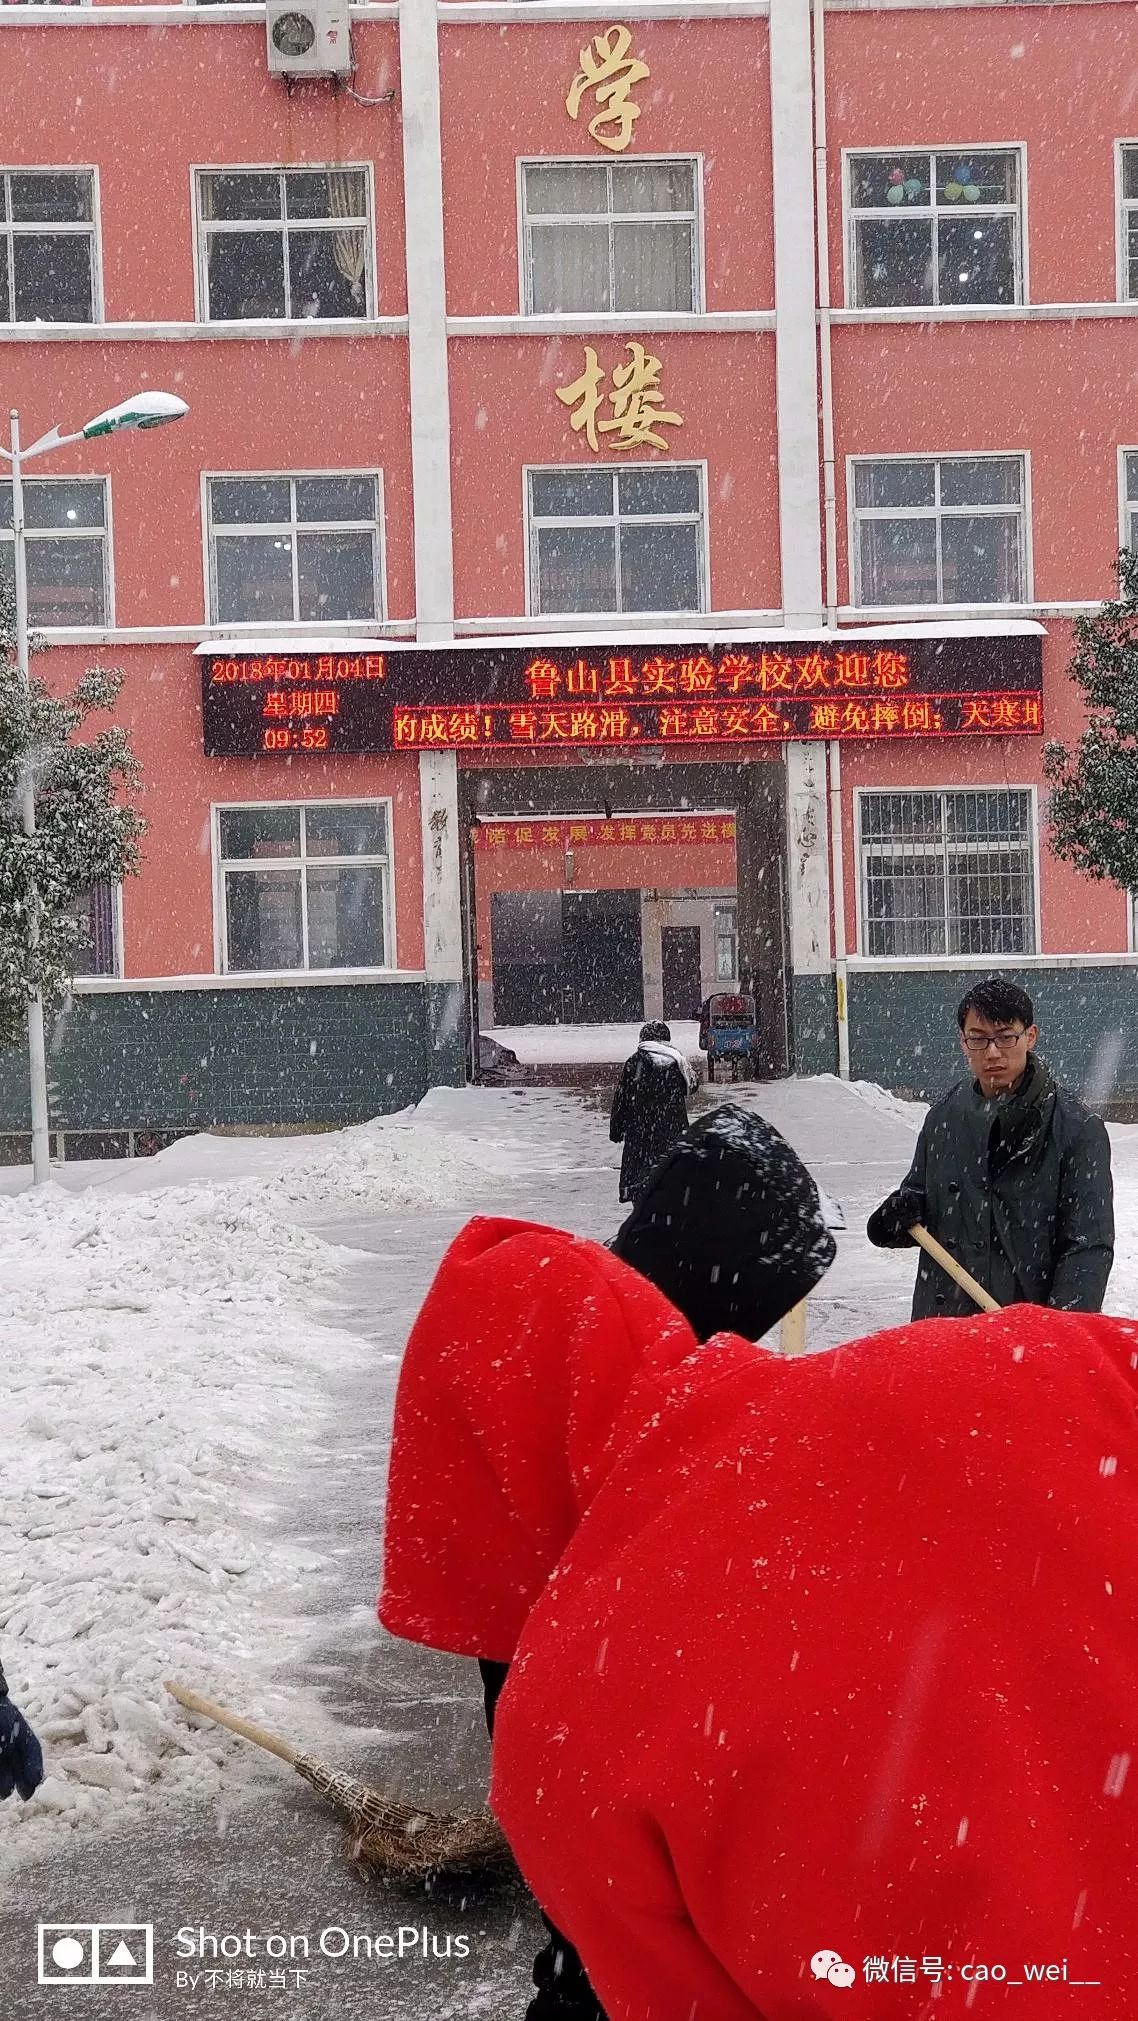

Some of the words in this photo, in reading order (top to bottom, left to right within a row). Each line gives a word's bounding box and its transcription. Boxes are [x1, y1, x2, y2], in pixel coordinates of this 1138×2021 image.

[211, 655, 384, 682] 2018年01月04日
[528, 653, 907, 698] 鲁山县实验学校欢迎您
[263, 690, 337, 716] 星期四
[264, 728, 328, 748] 09:52
